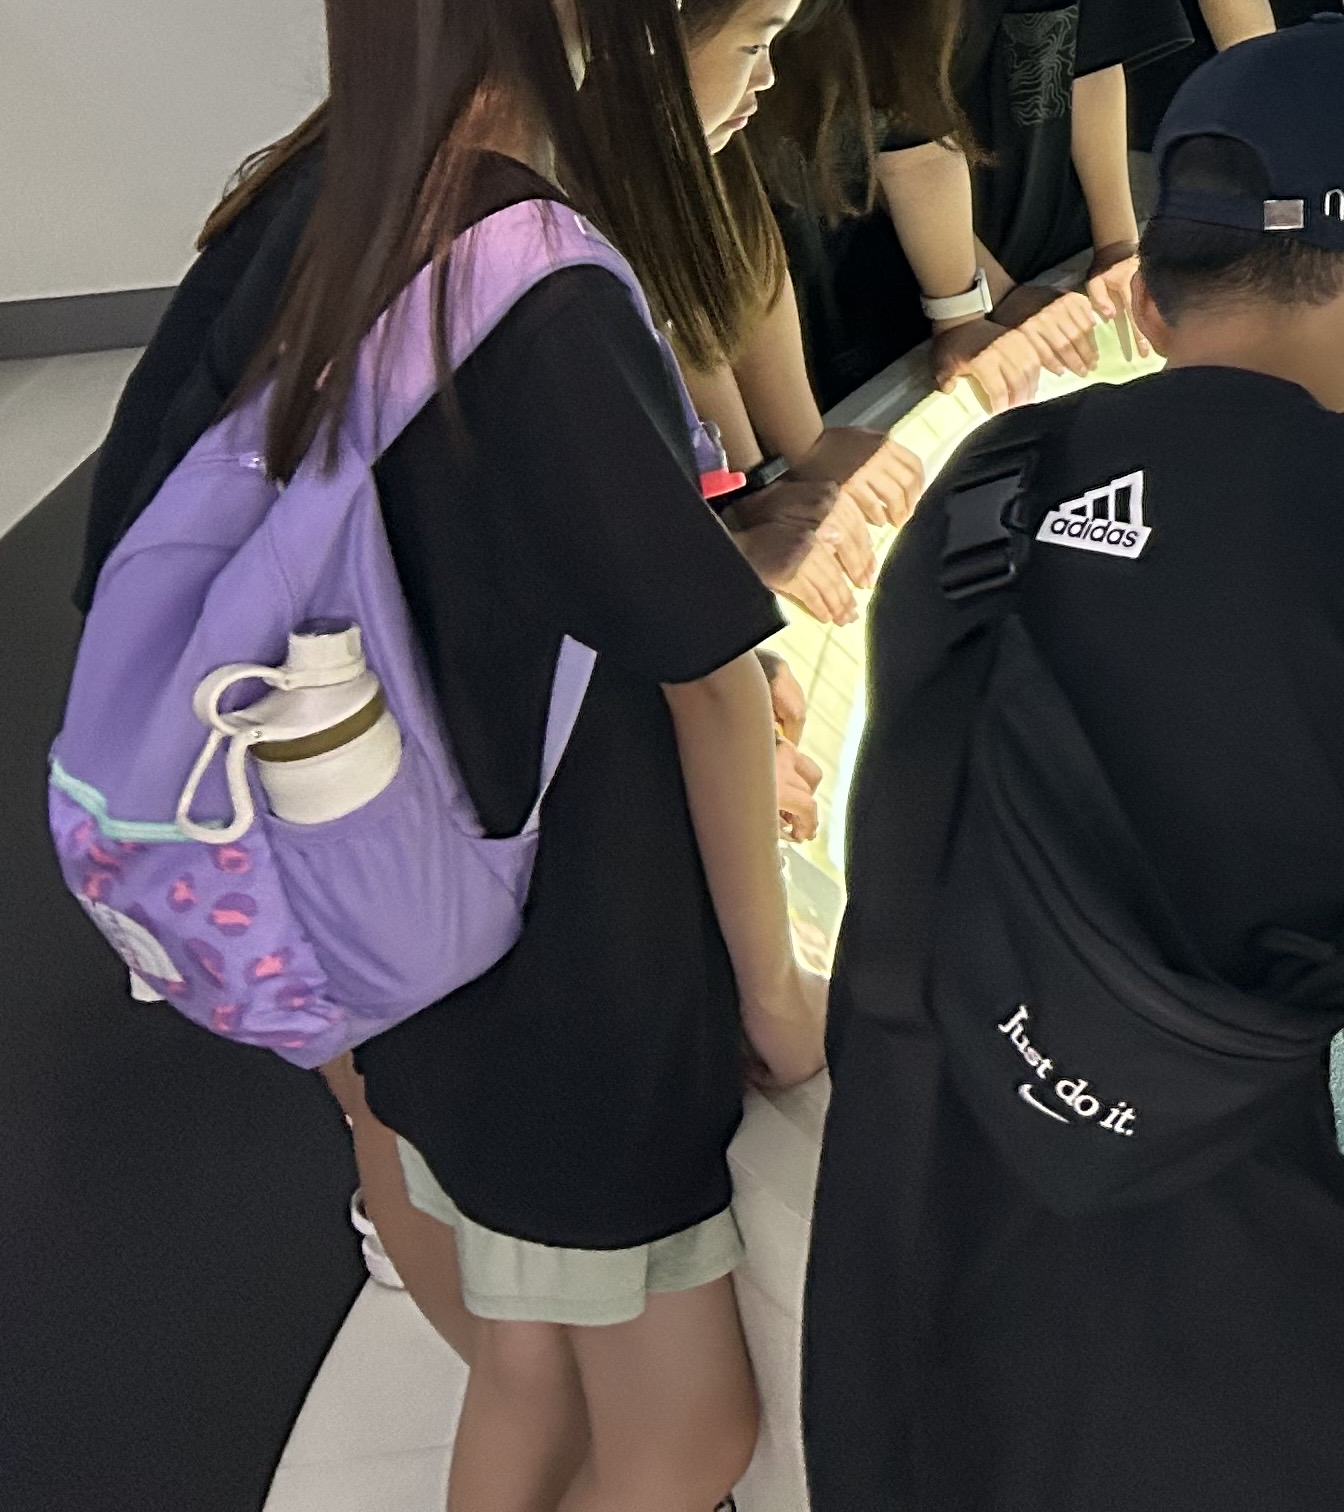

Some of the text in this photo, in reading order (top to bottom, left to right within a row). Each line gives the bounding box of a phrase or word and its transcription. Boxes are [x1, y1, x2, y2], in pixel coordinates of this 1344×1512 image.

[1051, 517, 1139, 548] adidas
[998, 1004, 1136, 1137] Just do it.
